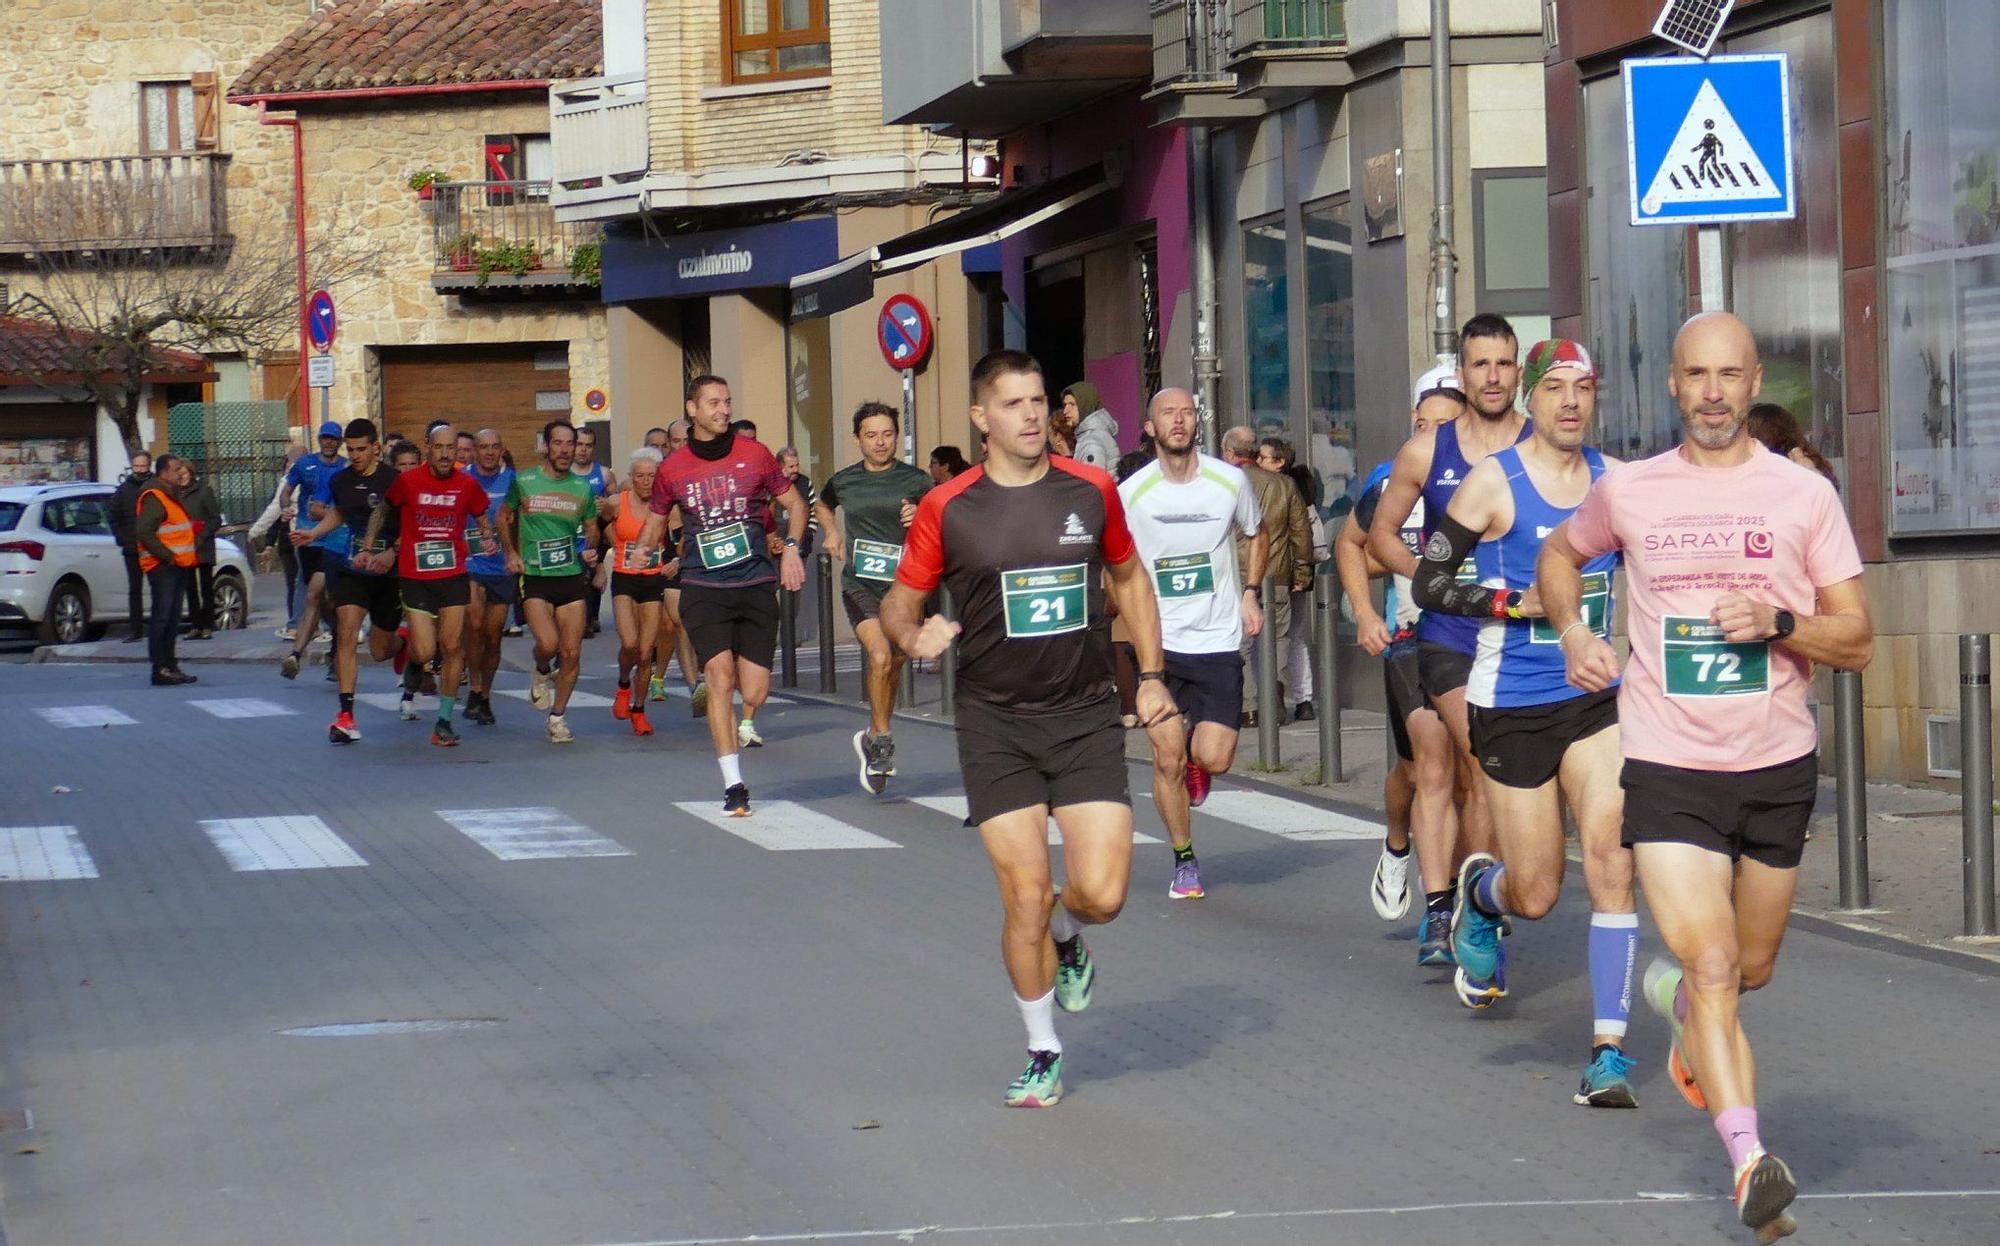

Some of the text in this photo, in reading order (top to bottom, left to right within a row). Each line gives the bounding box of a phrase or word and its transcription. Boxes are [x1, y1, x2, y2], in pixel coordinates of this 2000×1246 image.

[678, 243, 752, 279] azulmarino
[1736, 516, 1766, 527] 2025
[1644, 531, 1736, 551] SARAY
[426, 553, 445, 565] 69
[549, 549, 567, 563] 55
[713, 542, 737, 560] 68
[863, 557, 887, 573] 22
[1172, 572, 1198, 591] 57
[1029, 596, 1066, 624] 21
[1691, 652, 1742, 682] 72
